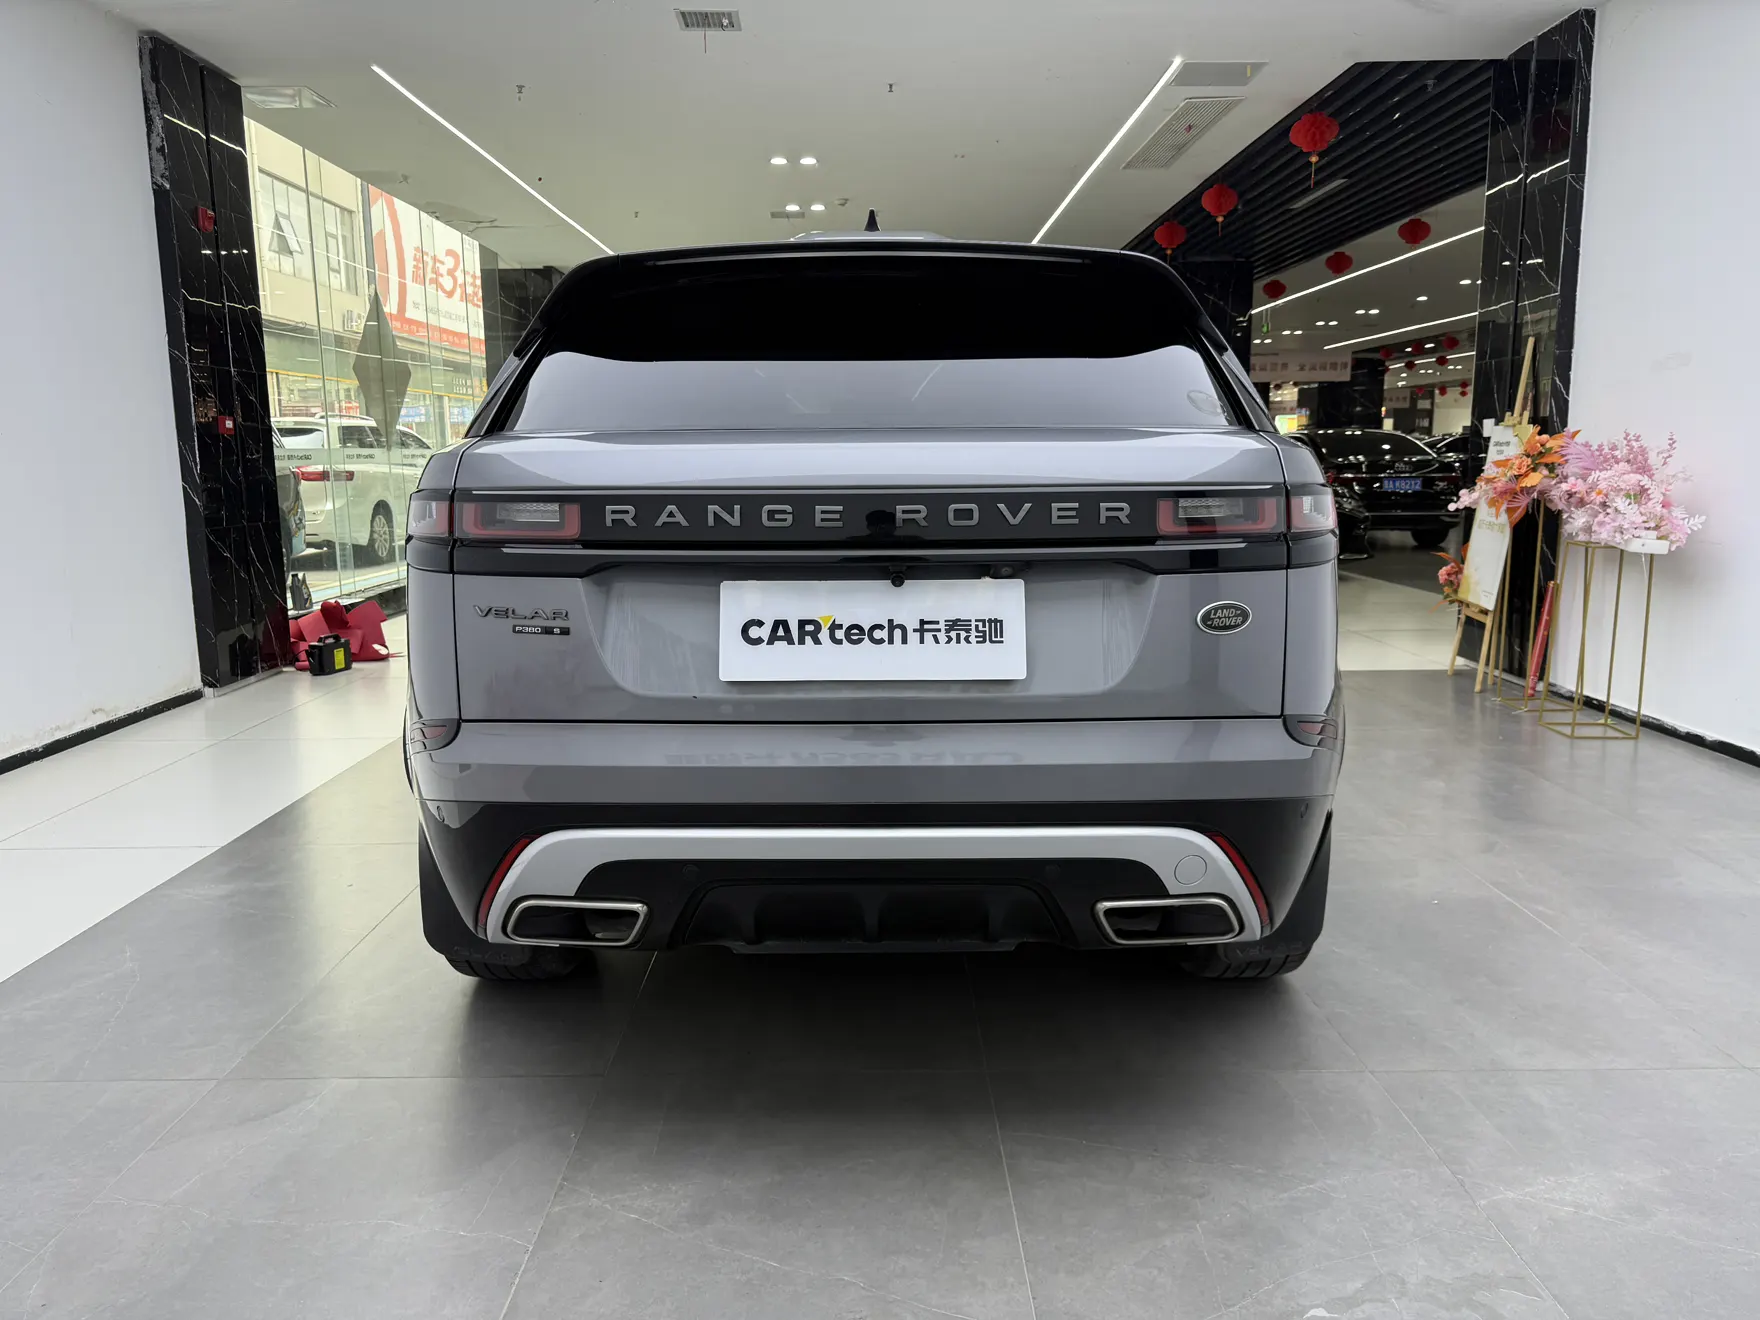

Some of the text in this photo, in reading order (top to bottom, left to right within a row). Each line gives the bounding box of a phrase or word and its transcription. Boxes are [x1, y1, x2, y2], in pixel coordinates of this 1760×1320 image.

[605, 502, 1131, 527] RANGE ROVER
[473, 605, 569, 621] VELAR
[1210, 608, 1236, 618] LAND
[1212, 617, 1243, 627] ROVER
[741, 616, 1004, 646] CARtech 卡泰驰
